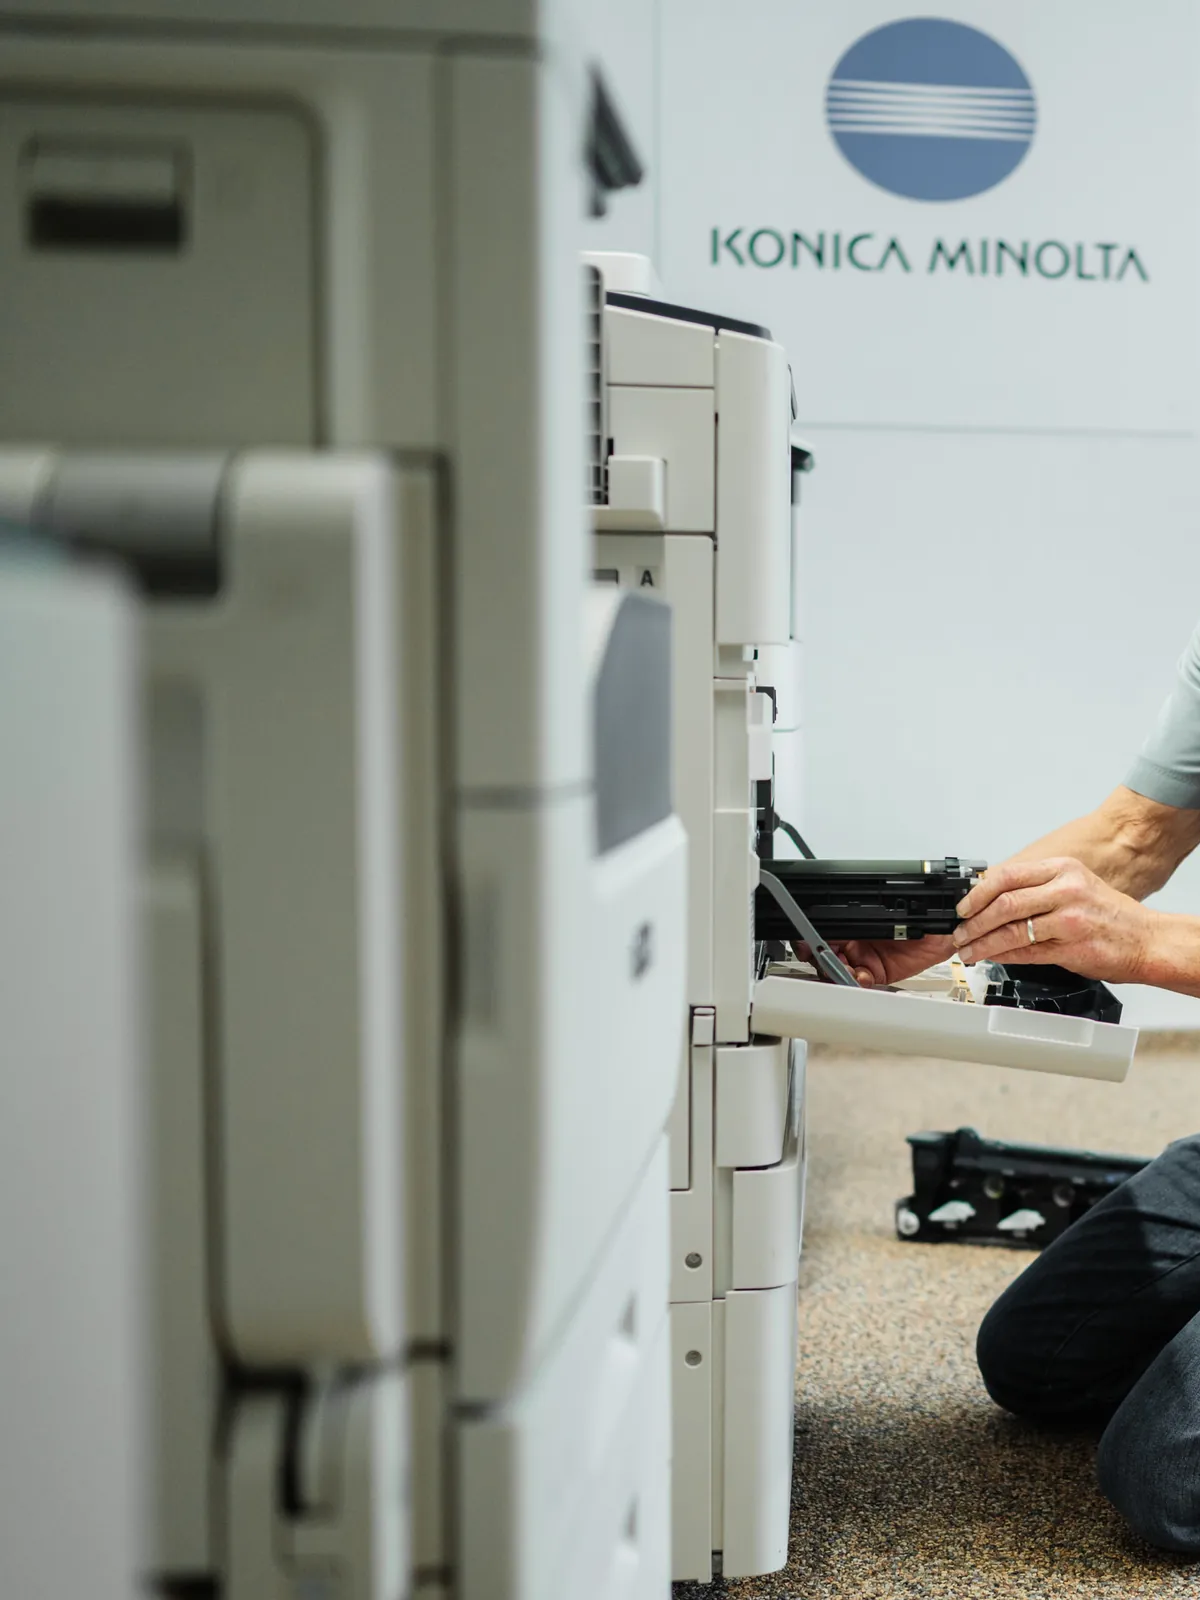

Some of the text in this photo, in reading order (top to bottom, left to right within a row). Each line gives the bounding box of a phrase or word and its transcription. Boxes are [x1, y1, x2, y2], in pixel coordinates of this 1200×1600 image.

[710, 227, 1150, 282] KONICA MINOLTA
[640, 570, 653, 586] A
